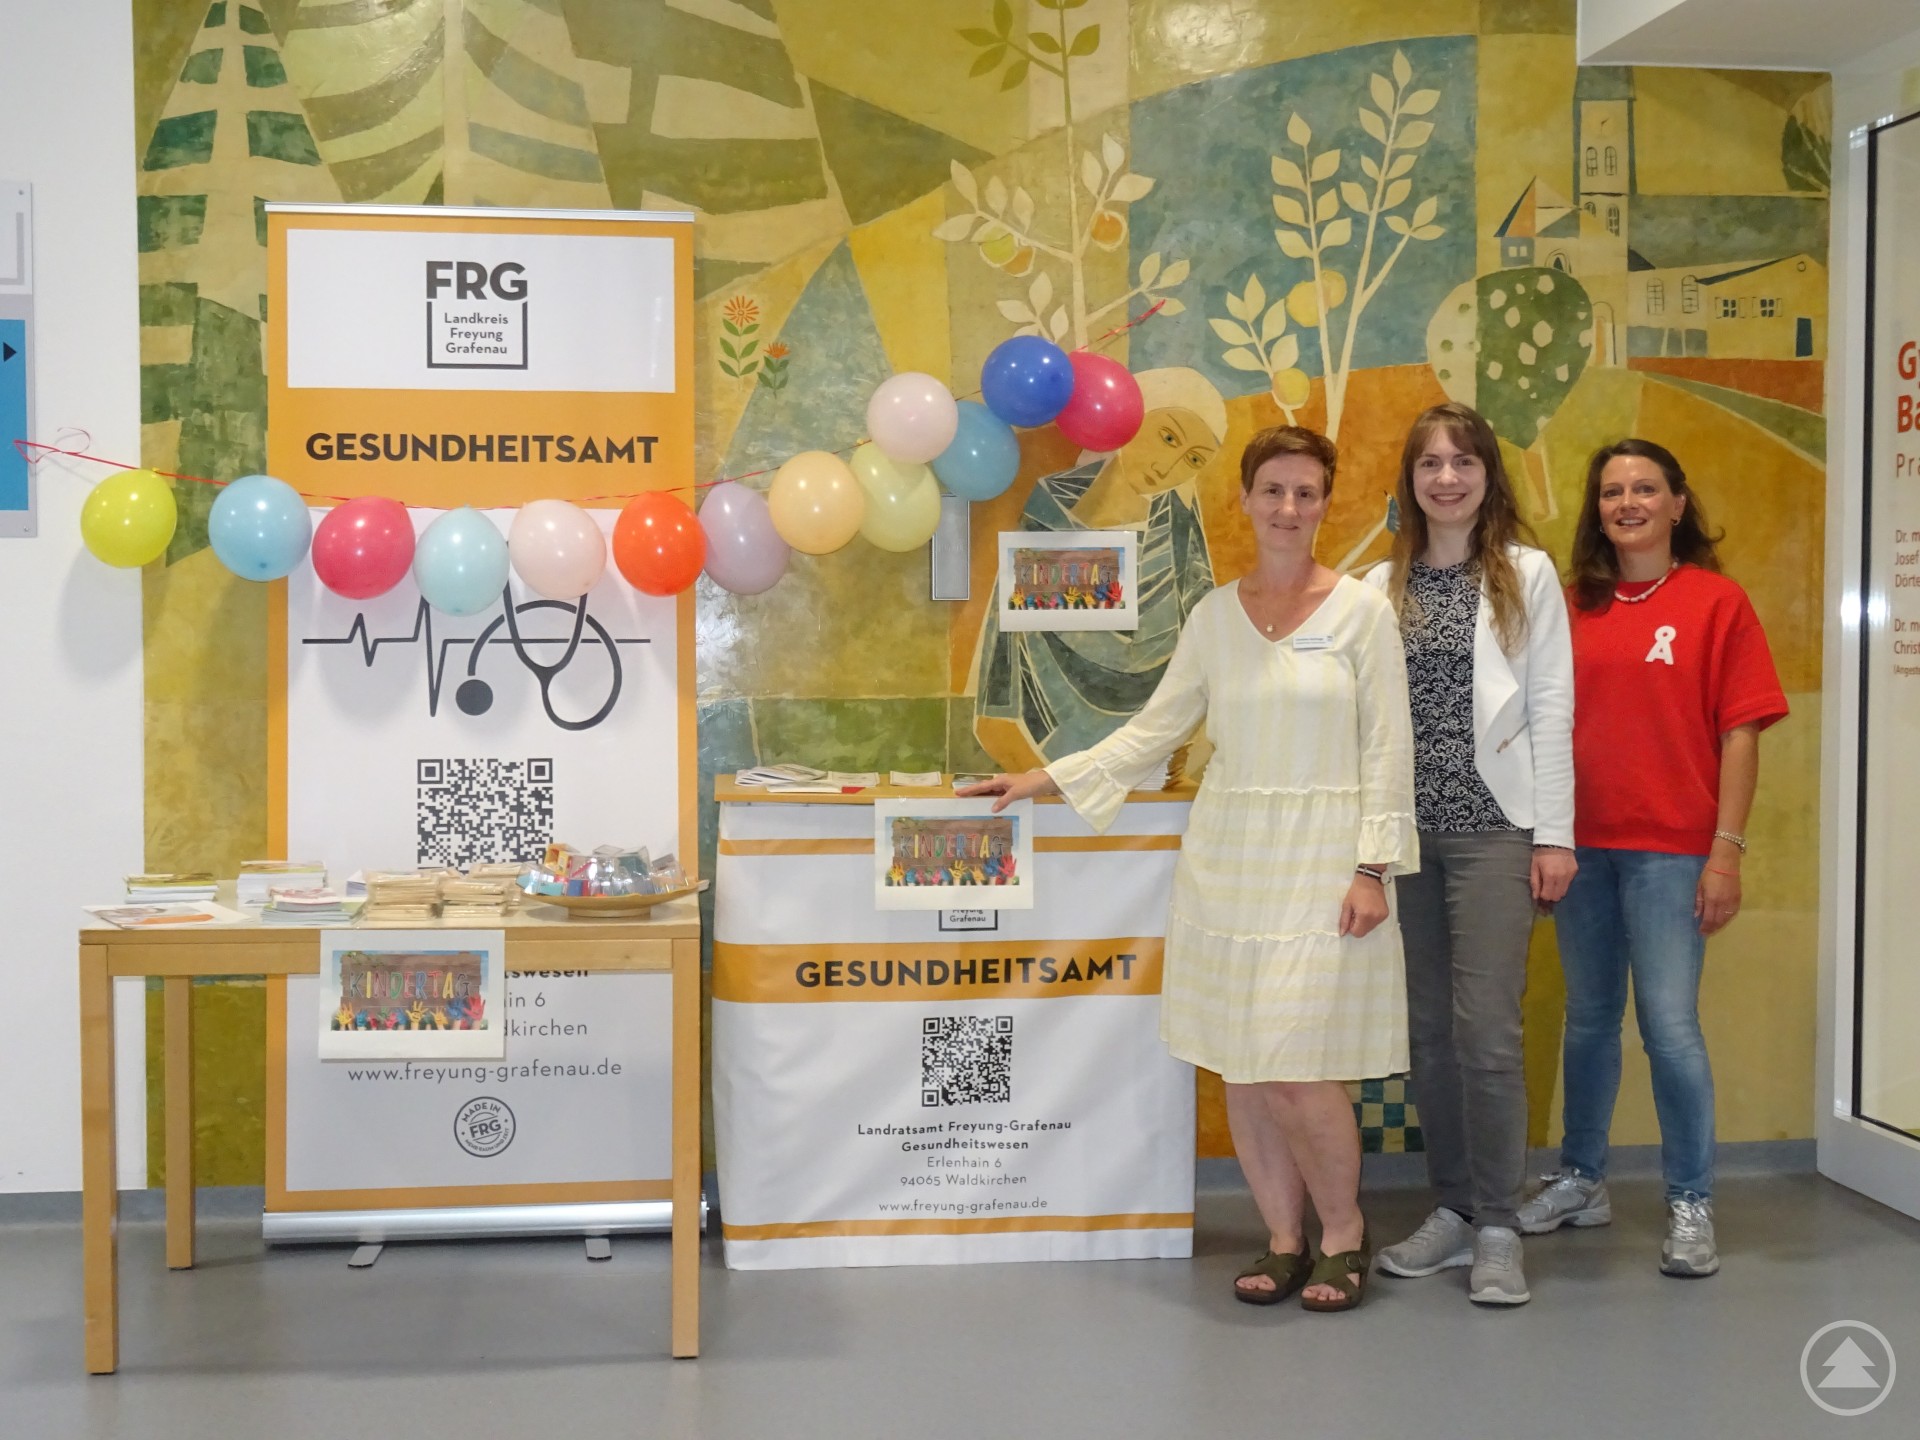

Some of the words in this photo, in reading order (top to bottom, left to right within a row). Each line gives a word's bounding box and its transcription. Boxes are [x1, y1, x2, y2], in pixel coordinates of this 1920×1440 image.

[426, 261, 528, 301] FRG
[444, 312, 509, 325] Landkreis
[450, 327, 503, 342] Freyung
[445, 342, 507, 354] Grafenau
[1898, 340, 1920, 385] G
[305, 432, 659, 464] GESUNDHEITSAMT
[1896, 452, 1920, 479] Pr
[1020, 563, 1112, 585] KINDERTAG
[899, 833, 1004, 859] KINDERTAG
[949, 914, 987, 923] Grafenau
[795, 954, 1137, 988] GESUNDHEITSAMT
[350, 971, 469, 999] KINDERTAG
[534, 991, 547, 1008] 6
[347, 1057, 623, 1085] www.freyung-grafenau.de
[462, 1102, 487, 1122] MADE
[489, 1103, 502, 1113] IN
[469, 1119, 502, 1138] FRG
[857, 1123, 944, 1136] Landratsamt
[948, 1120, 1072, 1134] Freyung-Grafenau
[901, 1138, 1029, 1152] Gesundheitswesen
[927, 1156, 990, 1169] Erlenhain
[994, 1157, 1002, 1168] 6
[900, 1174, 941, 1187] 94065
[945, 1174, 1027, 1186] Waldkirchen
[878, 1197, 1048, 1215] www.freyung-grafenau.de
